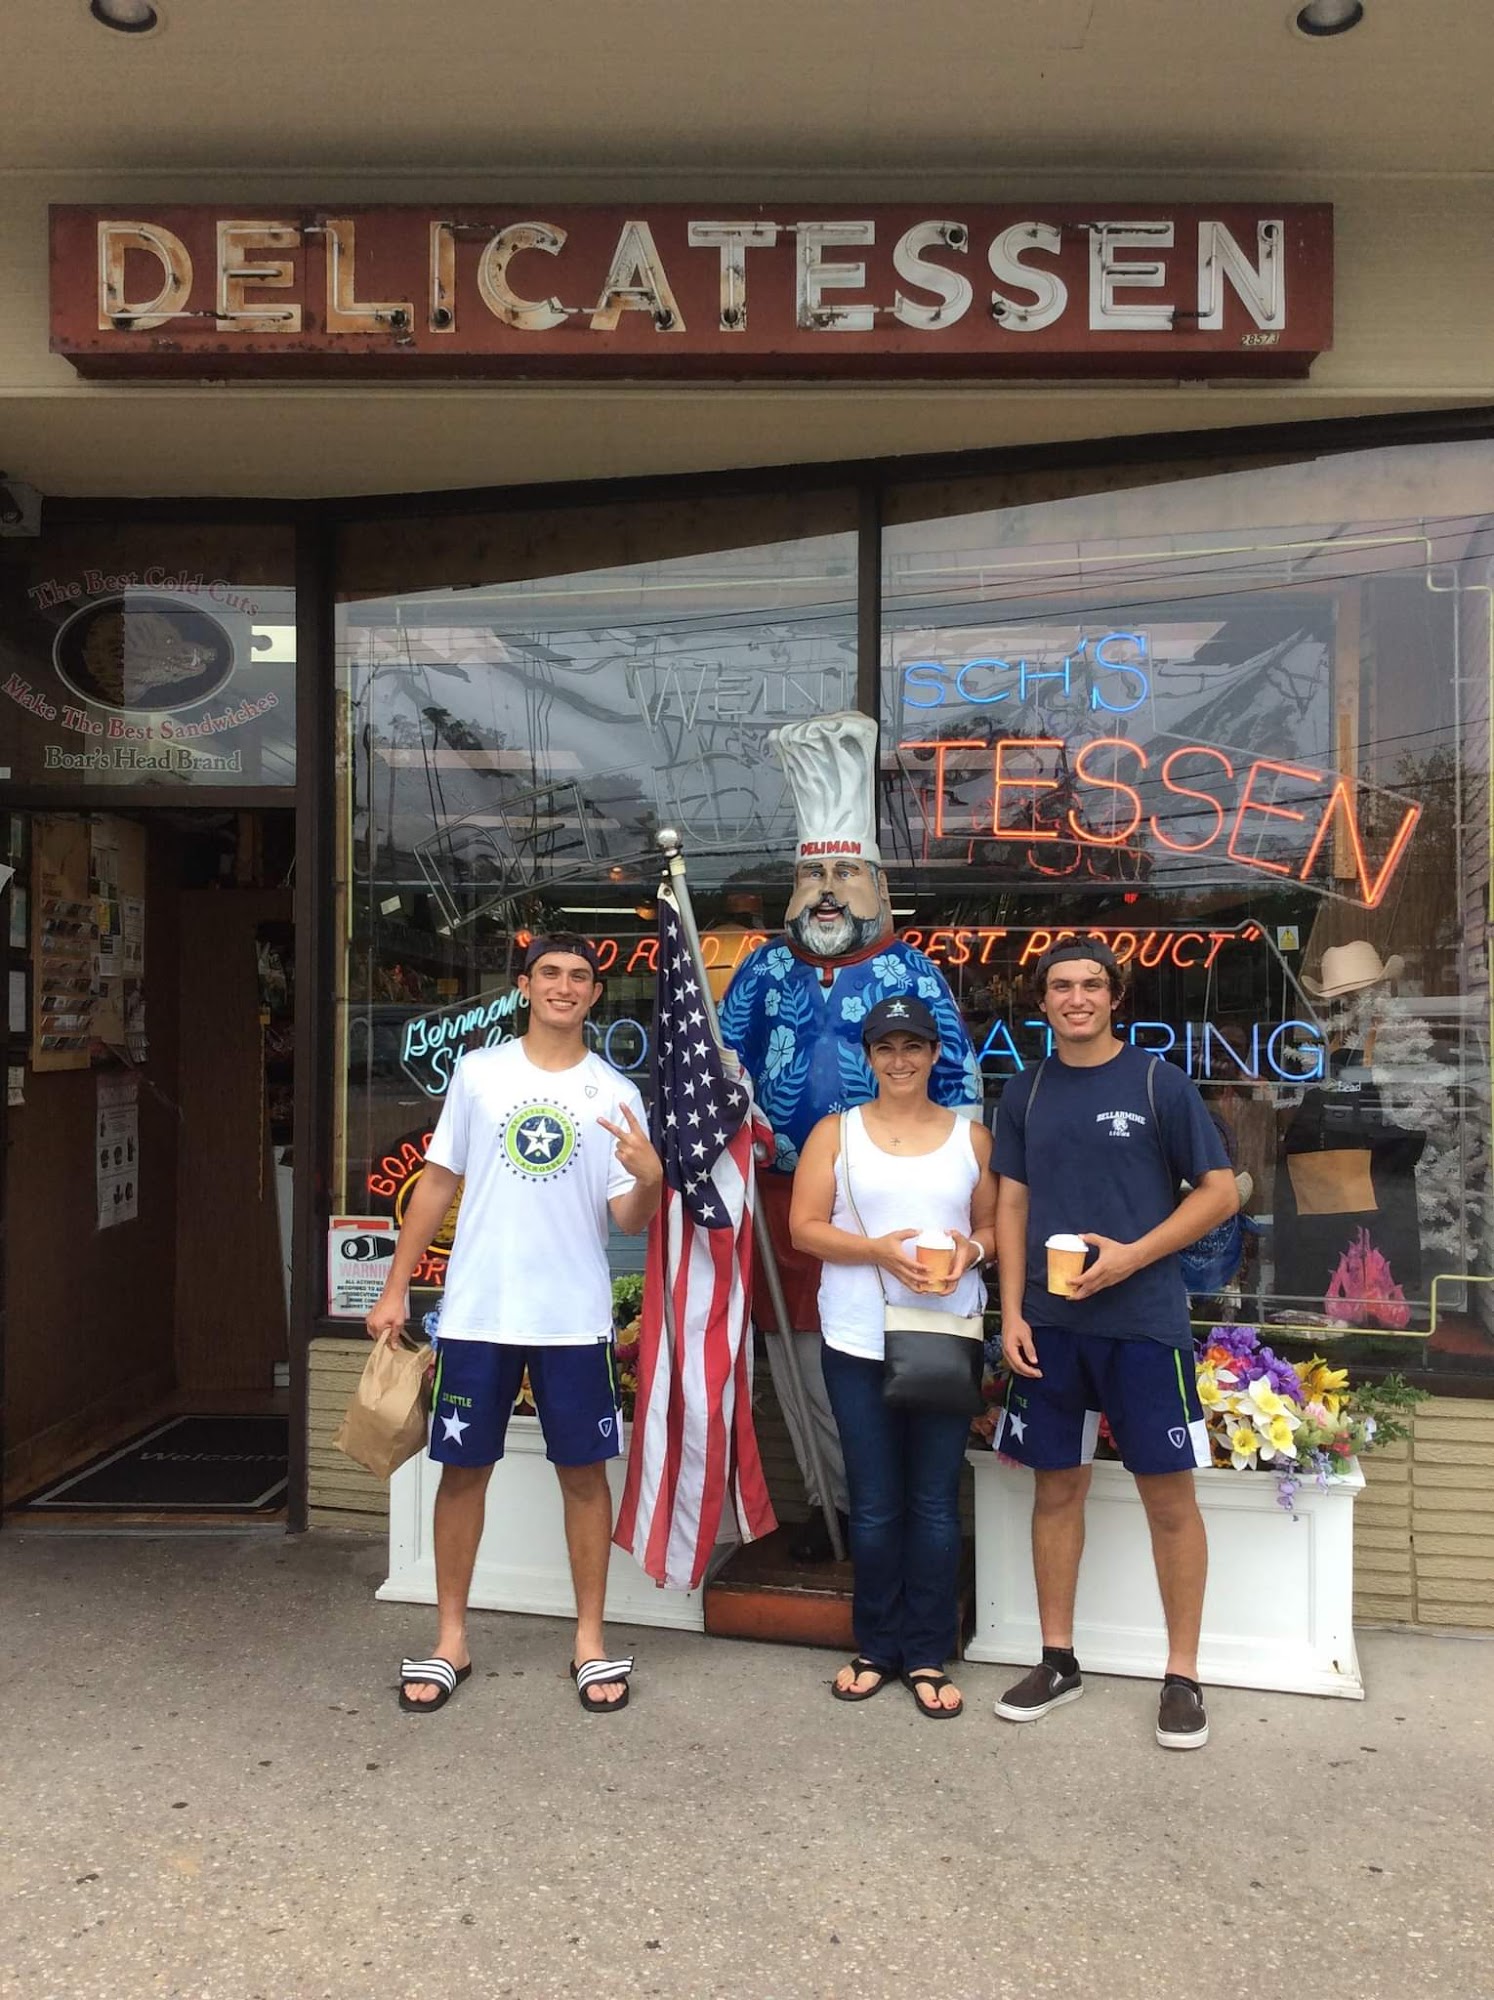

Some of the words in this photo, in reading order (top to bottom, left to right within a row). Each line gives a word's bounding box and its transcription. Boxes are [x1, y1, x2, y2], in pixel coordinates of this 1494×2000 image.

[97, 220, 1286, 333] DELICATESSEN
[29, 579, 80, 610] The
[84, 569, 139, 593] Best
[144, 566, 204, 596] Cold
[208, 579, 260, 618] Cuts
[902, 631, 1149, 714] SCH'S
[1, 673, 57, 721] Make
[62, 705, 104, 736] The
[108, 717, 154, 741] Best
[159, 691, 280, 741] Sandwiches
[45, 745, 109, 770] Boar's
[113, 747, 174, 772] Head
[176, 749, 243, 773] Brand
[898, 737, 1421, 907] TESSEN
[340, 1263, 391, 1279] WARNI
